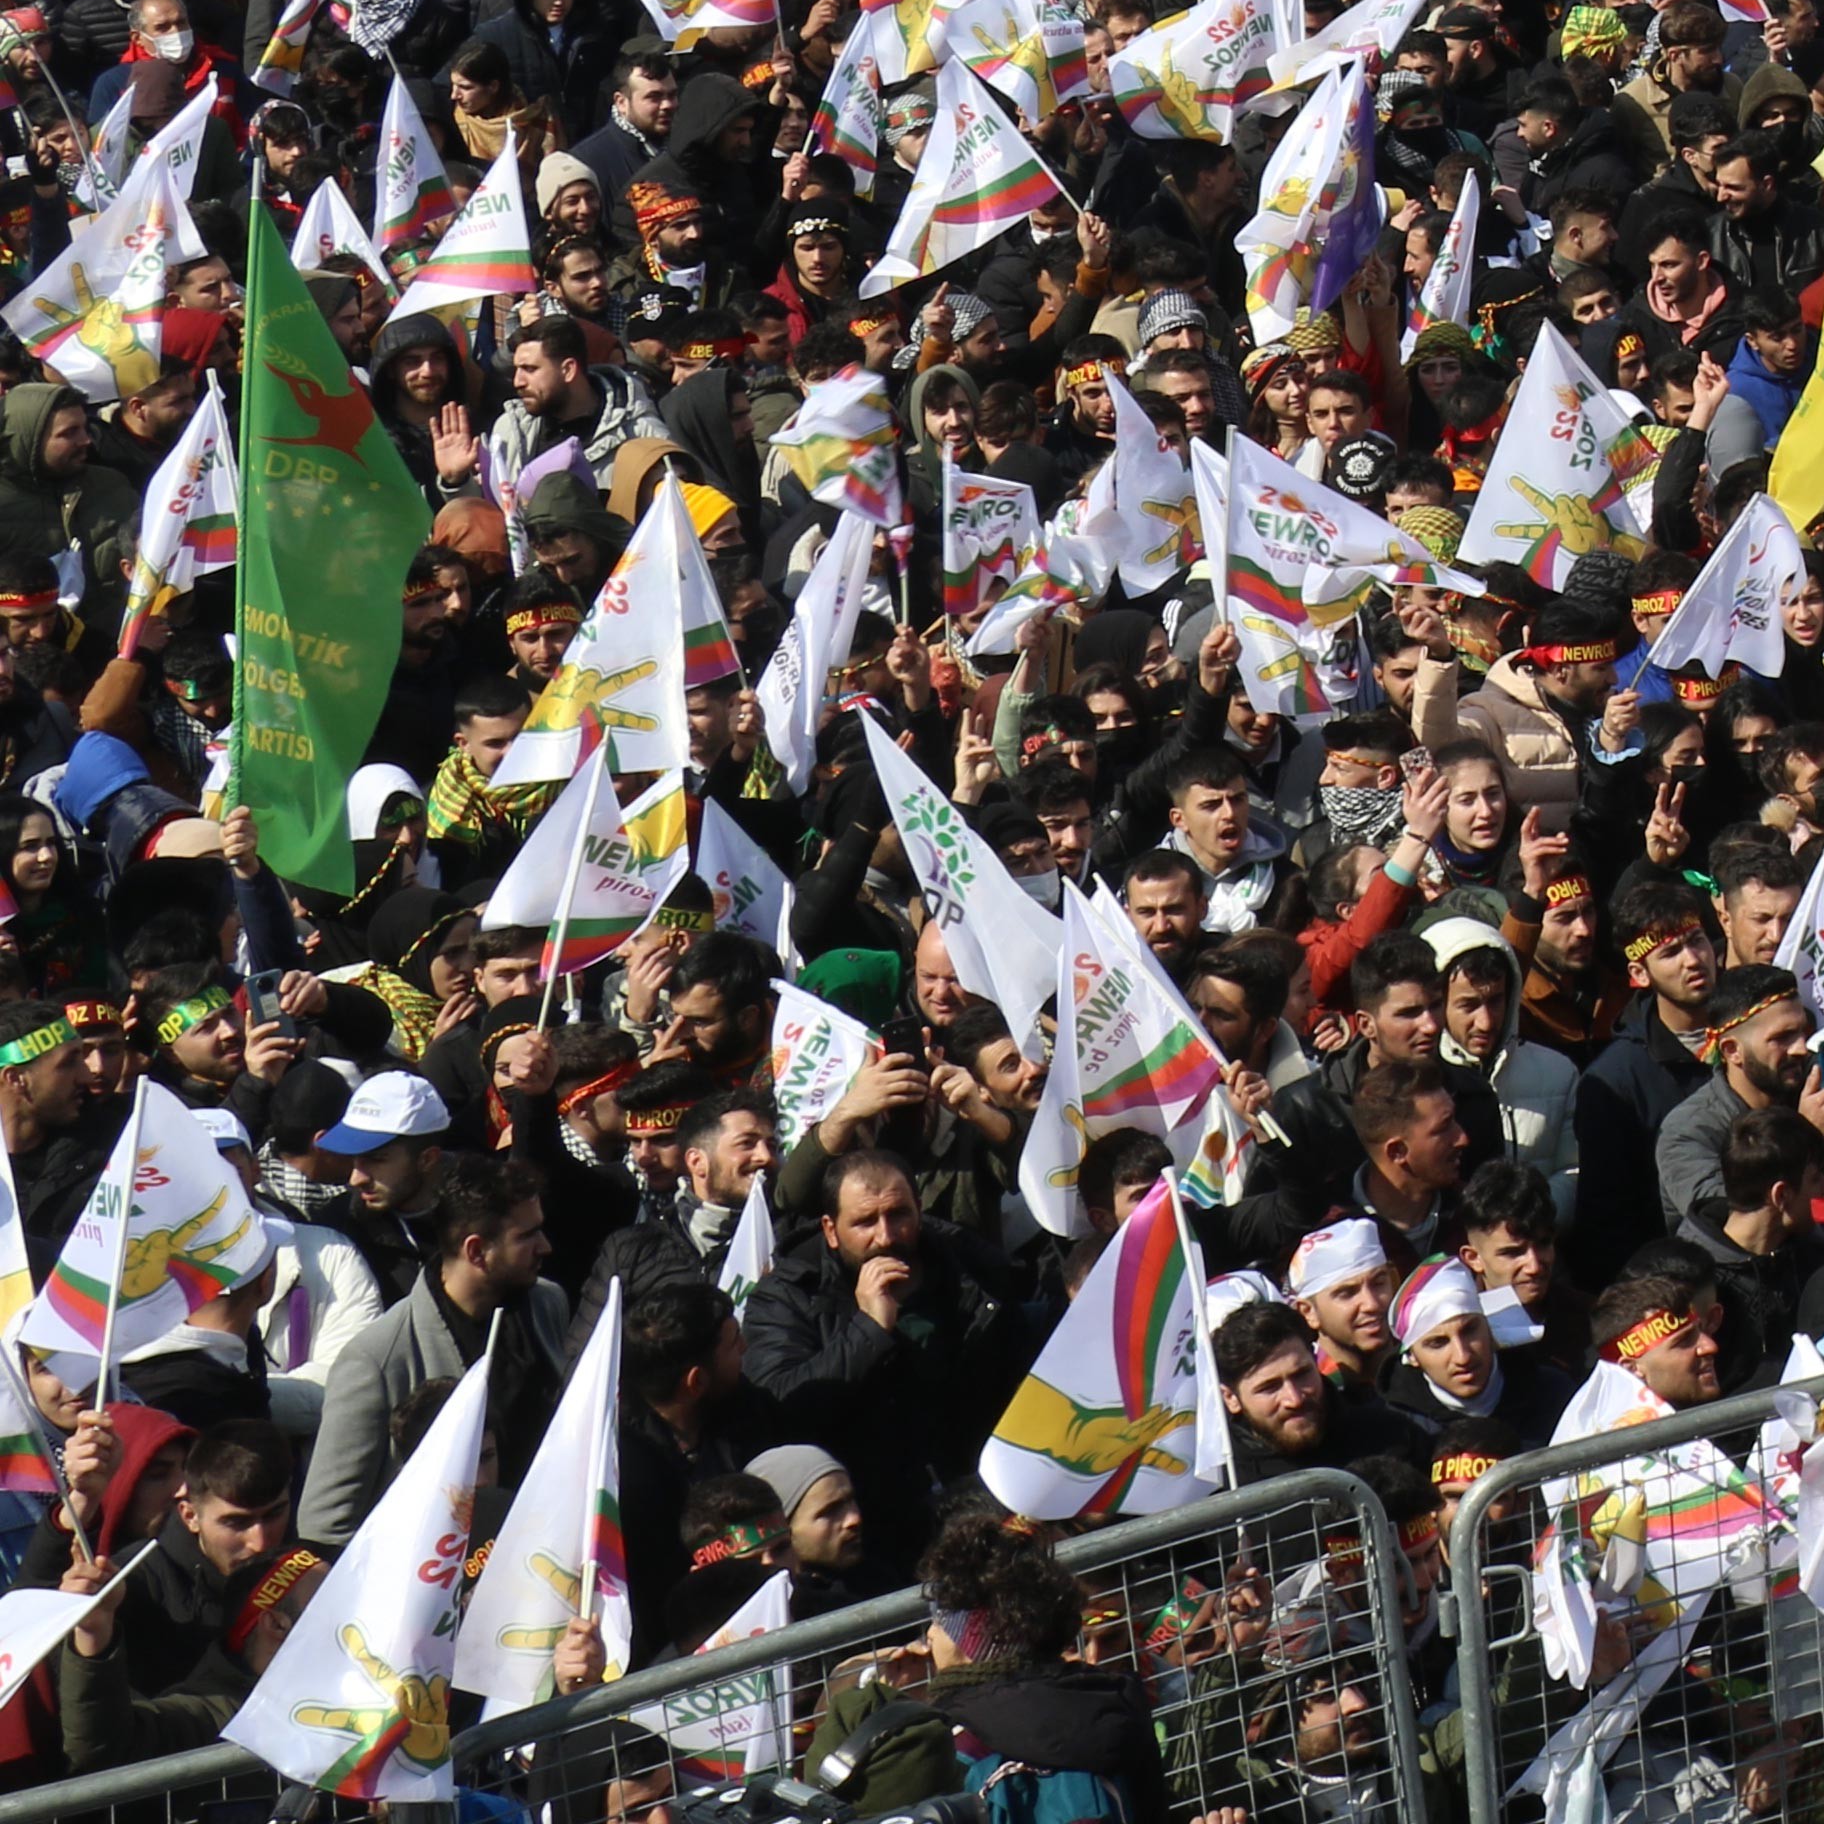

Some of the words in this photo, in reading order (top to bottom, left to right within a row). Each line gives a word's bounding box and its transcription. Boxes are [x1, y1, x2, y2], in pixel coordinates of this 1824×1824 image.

[265, 451, 339, 486] DBP
[19, 1021, 70, 1060] HDP
[253, 1550, 318, 1610] NEWROZ
